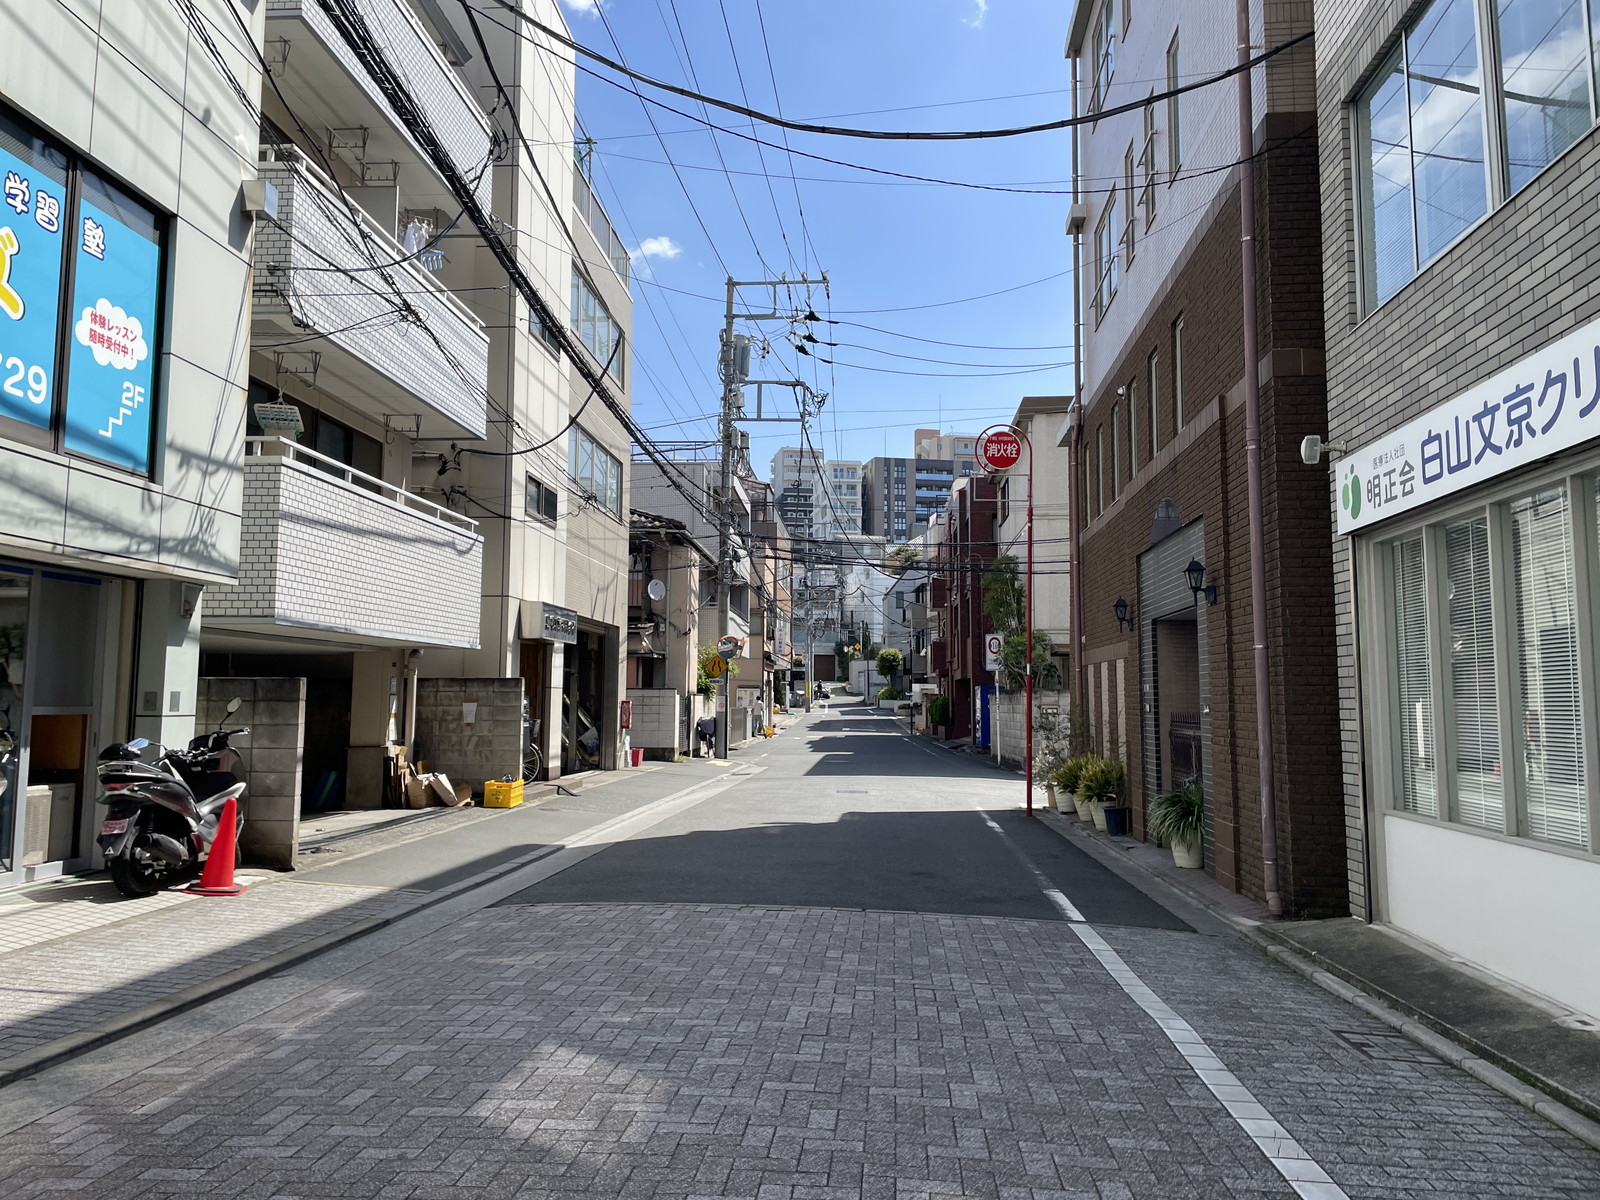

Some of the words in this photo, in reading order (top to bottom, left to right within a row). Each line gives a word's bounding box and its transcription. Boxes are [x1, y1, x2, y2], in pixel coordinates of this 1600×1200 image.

[89, 310, 137, 342] 体験レッスン
[0, 352, 48, 404] 29
[121, 380, 145, 409] 2F
[1366, 459, 1416, 509] 明正会
[1420, 344, 1600, 486] 白山文京クリ
[986, 442, 1019, 458] 消火栓
[1372, 443, 1406, 470] 医療法人社団
